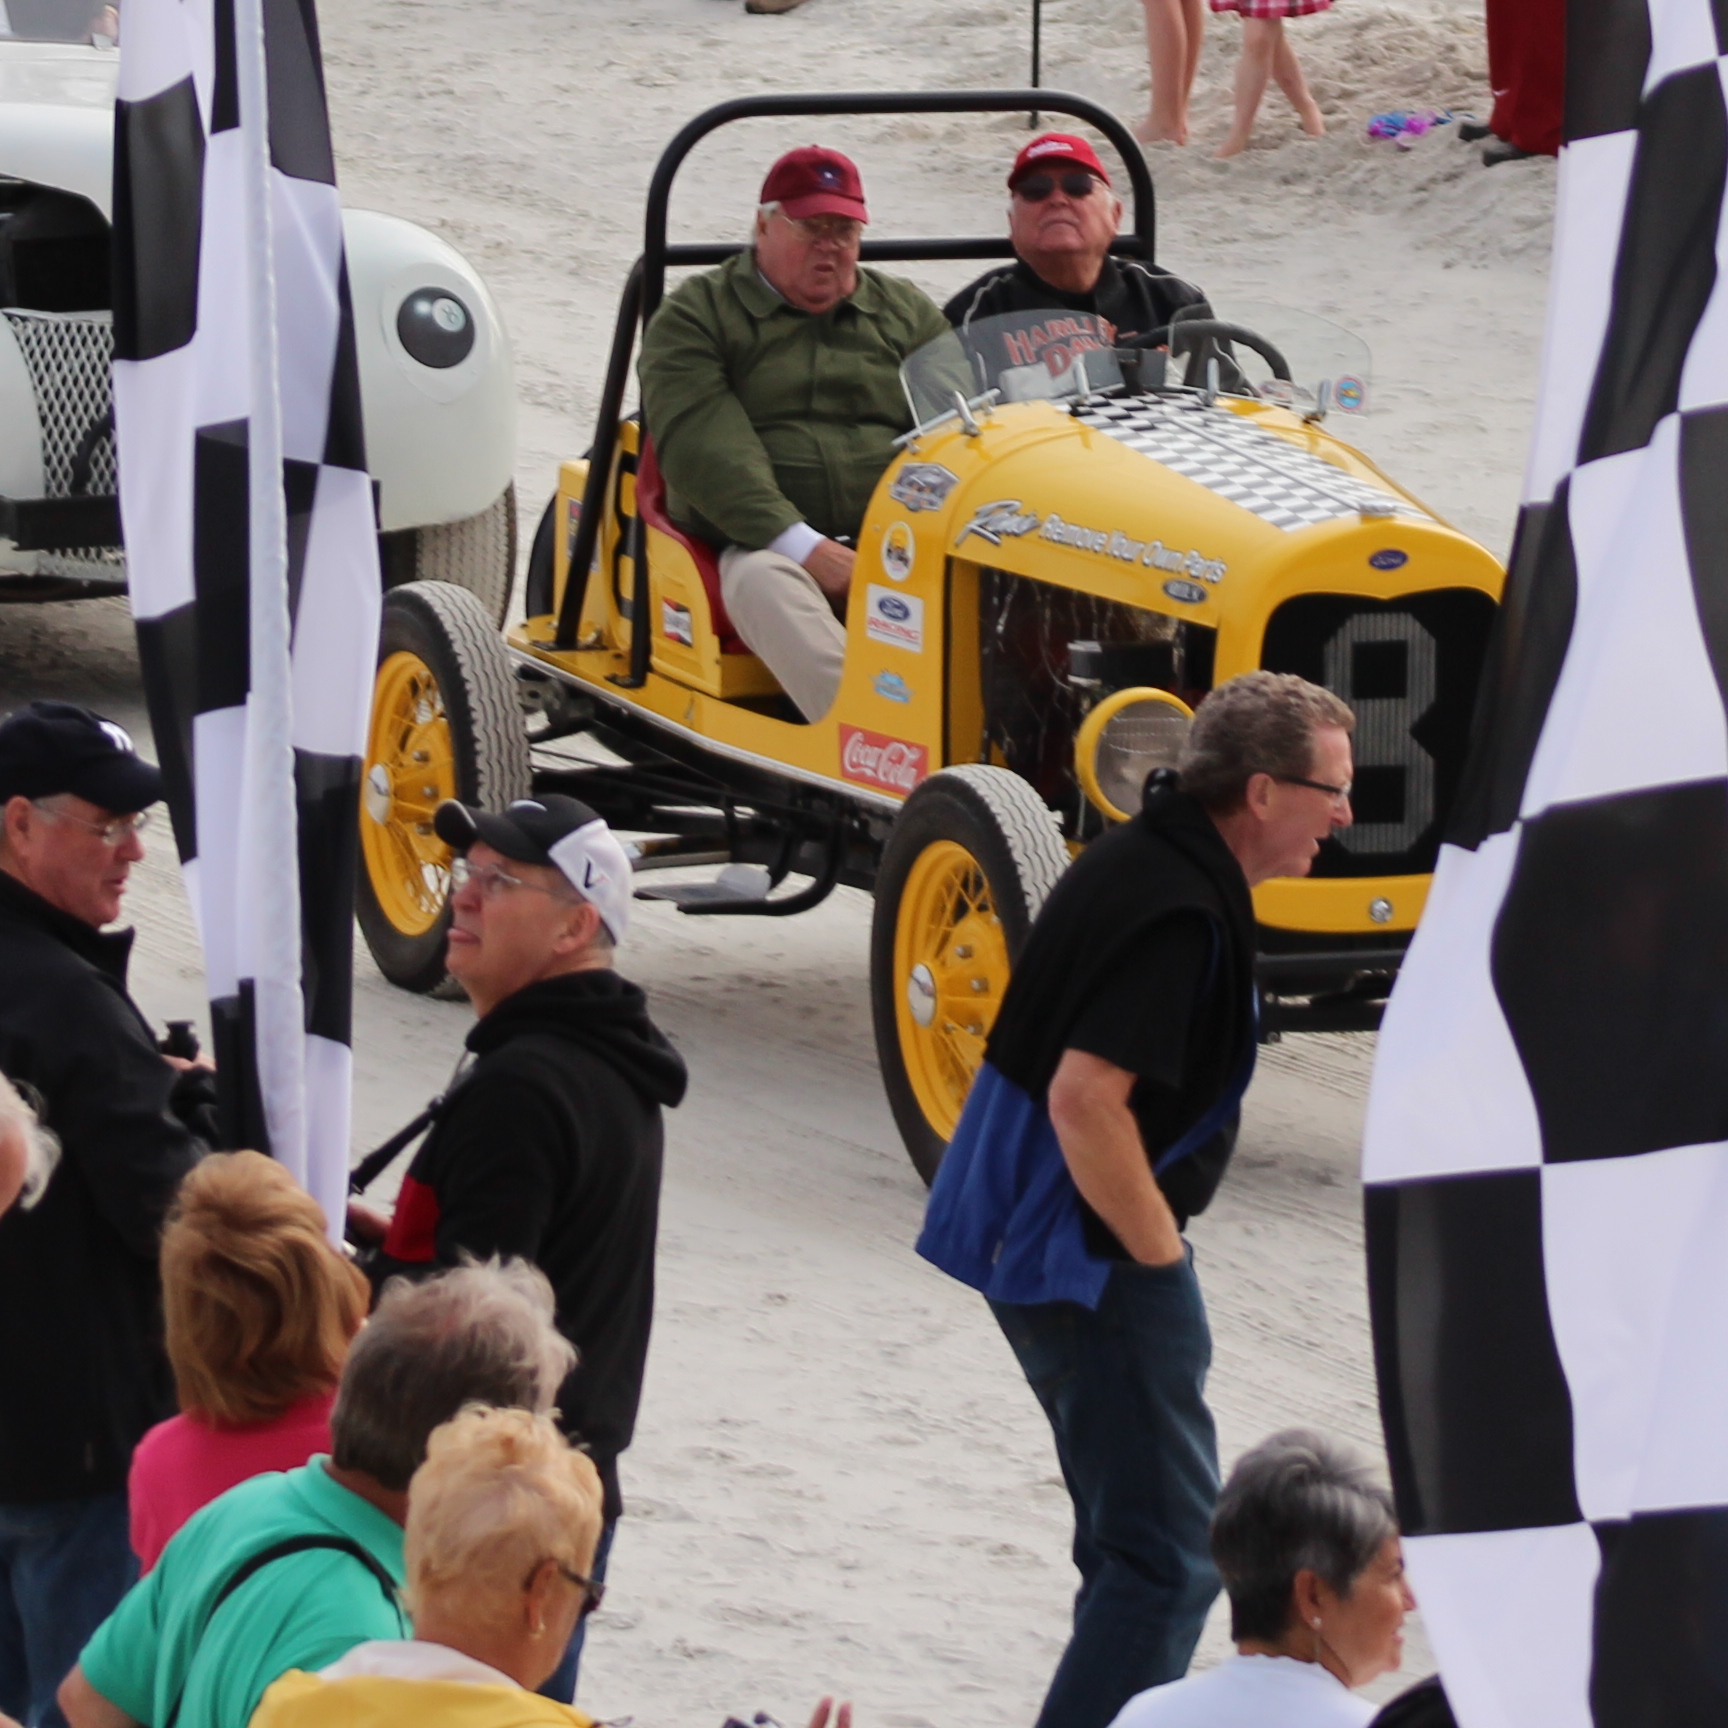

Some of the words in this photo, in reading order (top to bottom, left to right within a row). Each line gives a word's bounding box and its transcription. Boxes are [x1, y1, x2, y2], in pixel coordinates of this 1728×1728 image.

[1038, 512, 1109, 553] Remove
[1106, 528, 1146, 562] Your
[1142, 539, 1183, 574] Own
[1182, 549, 1228, 584] Parts
